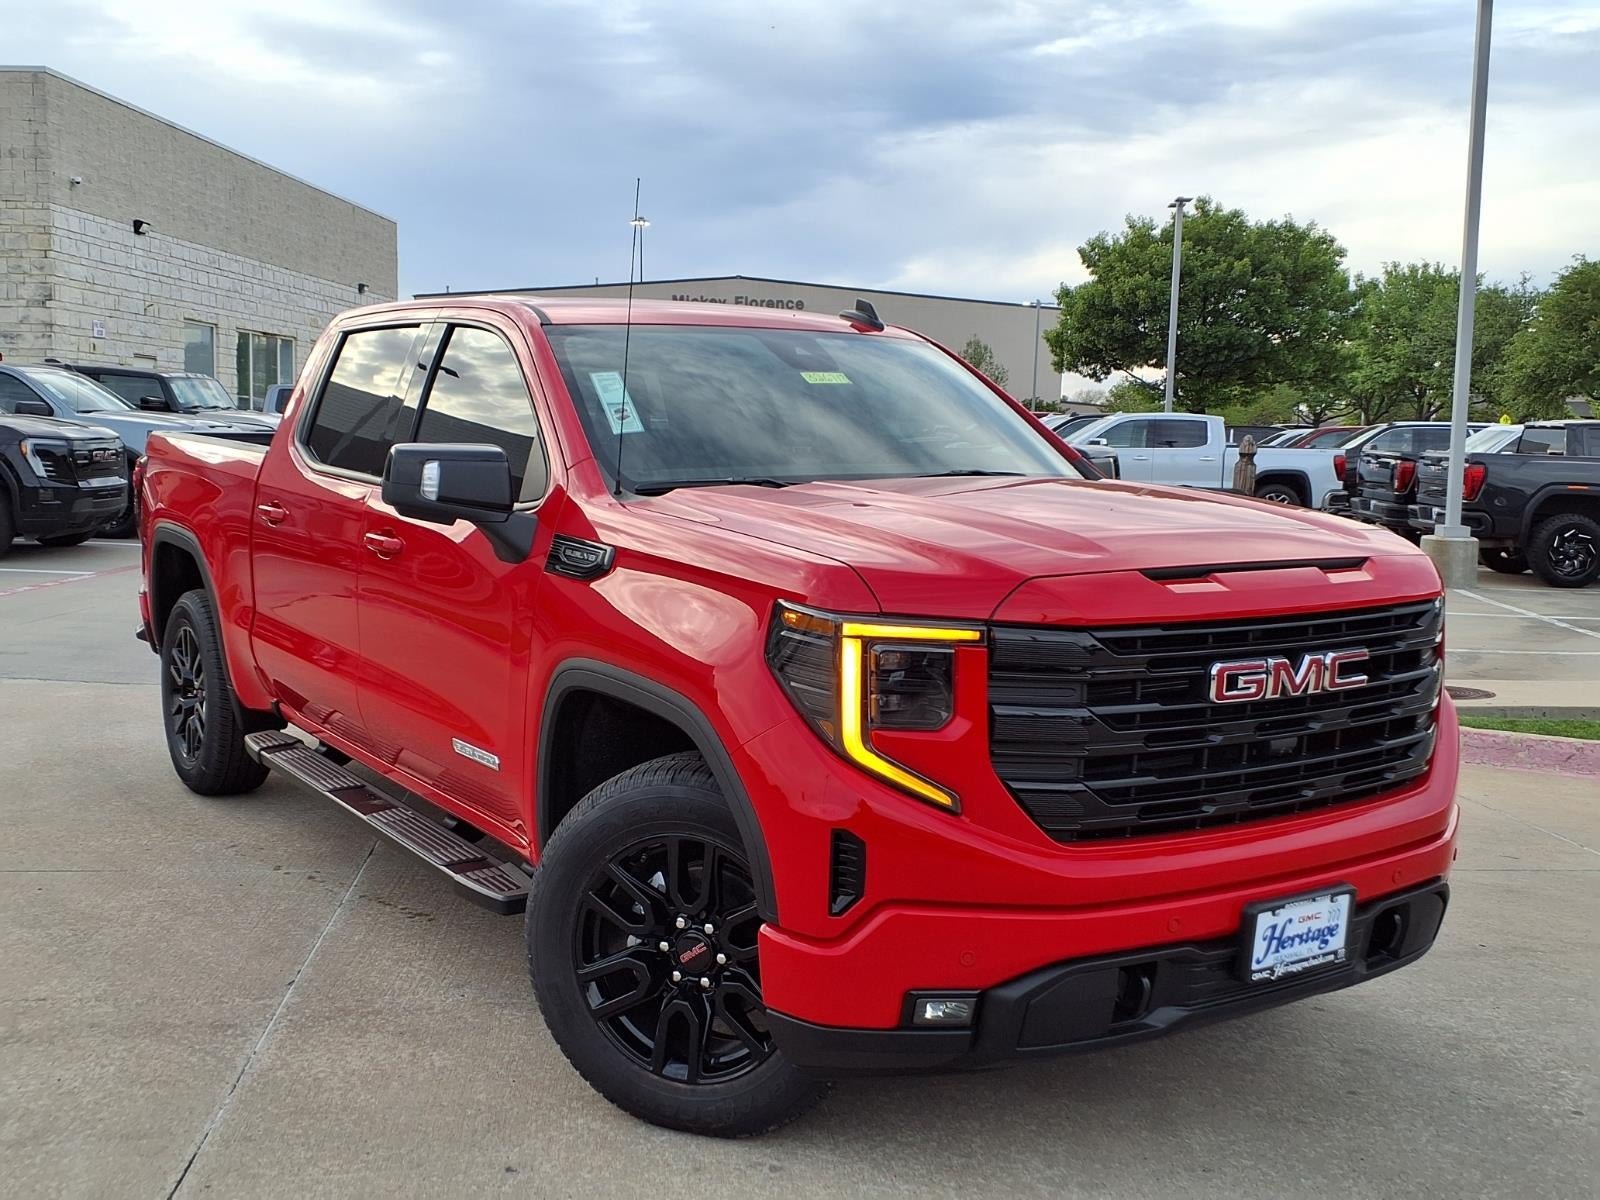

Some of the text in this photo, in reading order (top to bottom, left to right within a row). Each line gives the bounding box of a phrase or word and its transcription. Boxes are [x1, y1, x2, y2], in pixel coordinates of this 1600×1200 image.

[734, 295, 805, 310] Florence
[93, 450, 116, 460] GMC
[1209, 648, 1370, 704] GMC
[1298, 911, 1322, 924] GMC
[1255, 917, 1340, 965] Heritage
[679, 942, 707, 963] GMC
